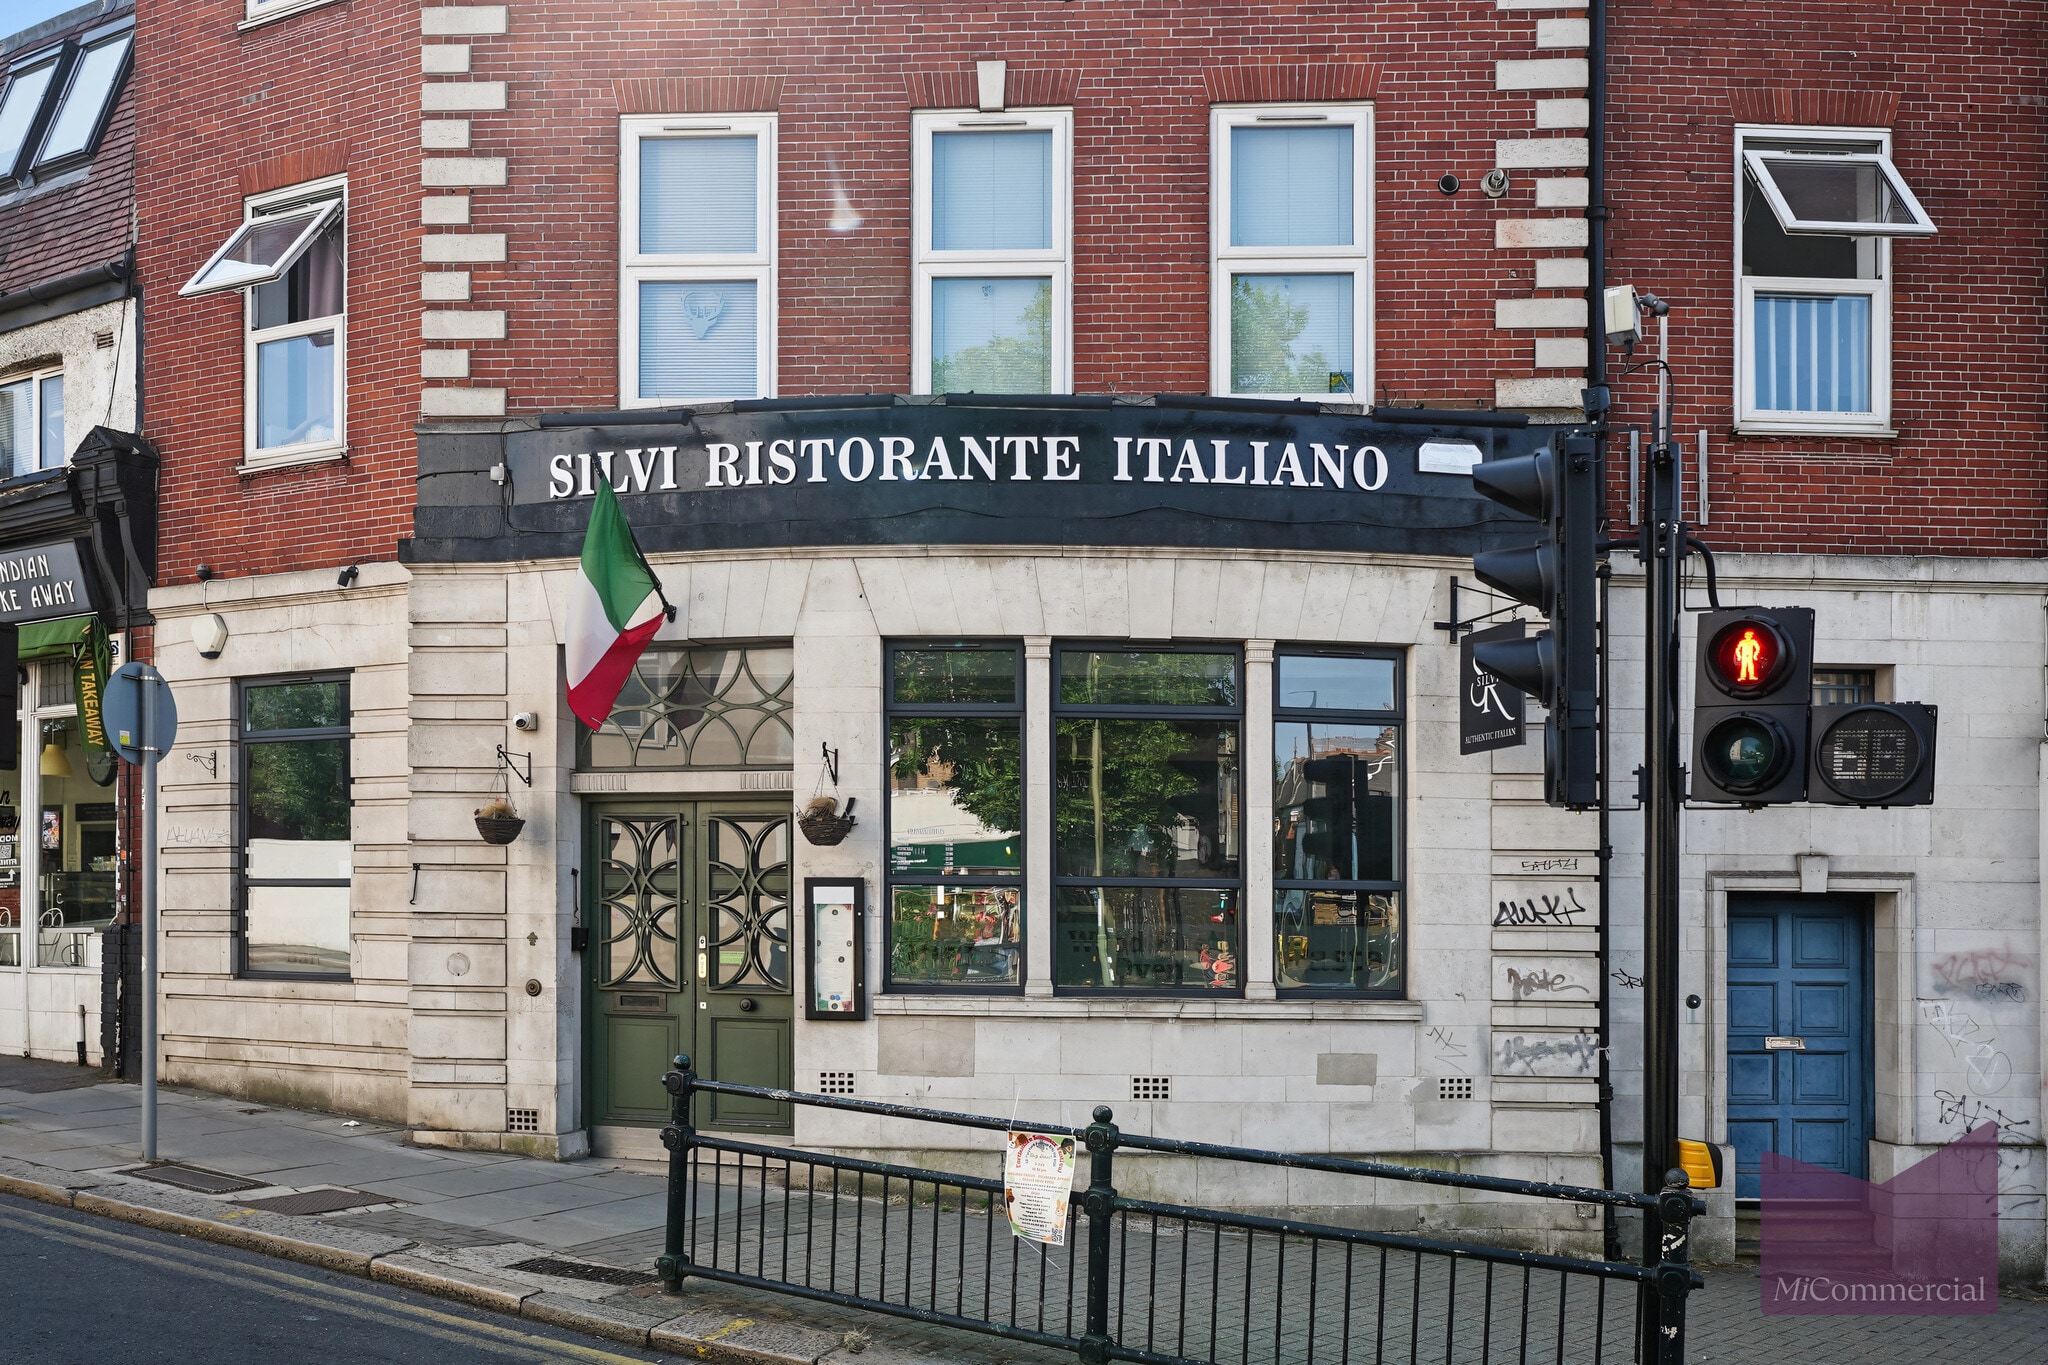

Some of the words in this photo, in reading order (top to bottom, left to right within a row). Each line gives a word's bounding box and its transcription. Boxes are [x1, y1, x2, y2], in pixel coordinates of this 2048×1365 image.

[549, 447, 678, 498] SILVI
[705, 436, 1081, 488] RISTORANTE
[1113, 437, 1389, 491] ITALIANO
[30, 580, 75, 608] AWAY
[80, 672, 104, 746] TAKEAWAY
[1464, 731, 1494, 744] AUTHENTIC
[1494, 727, 1517, 740] ITALIAN
